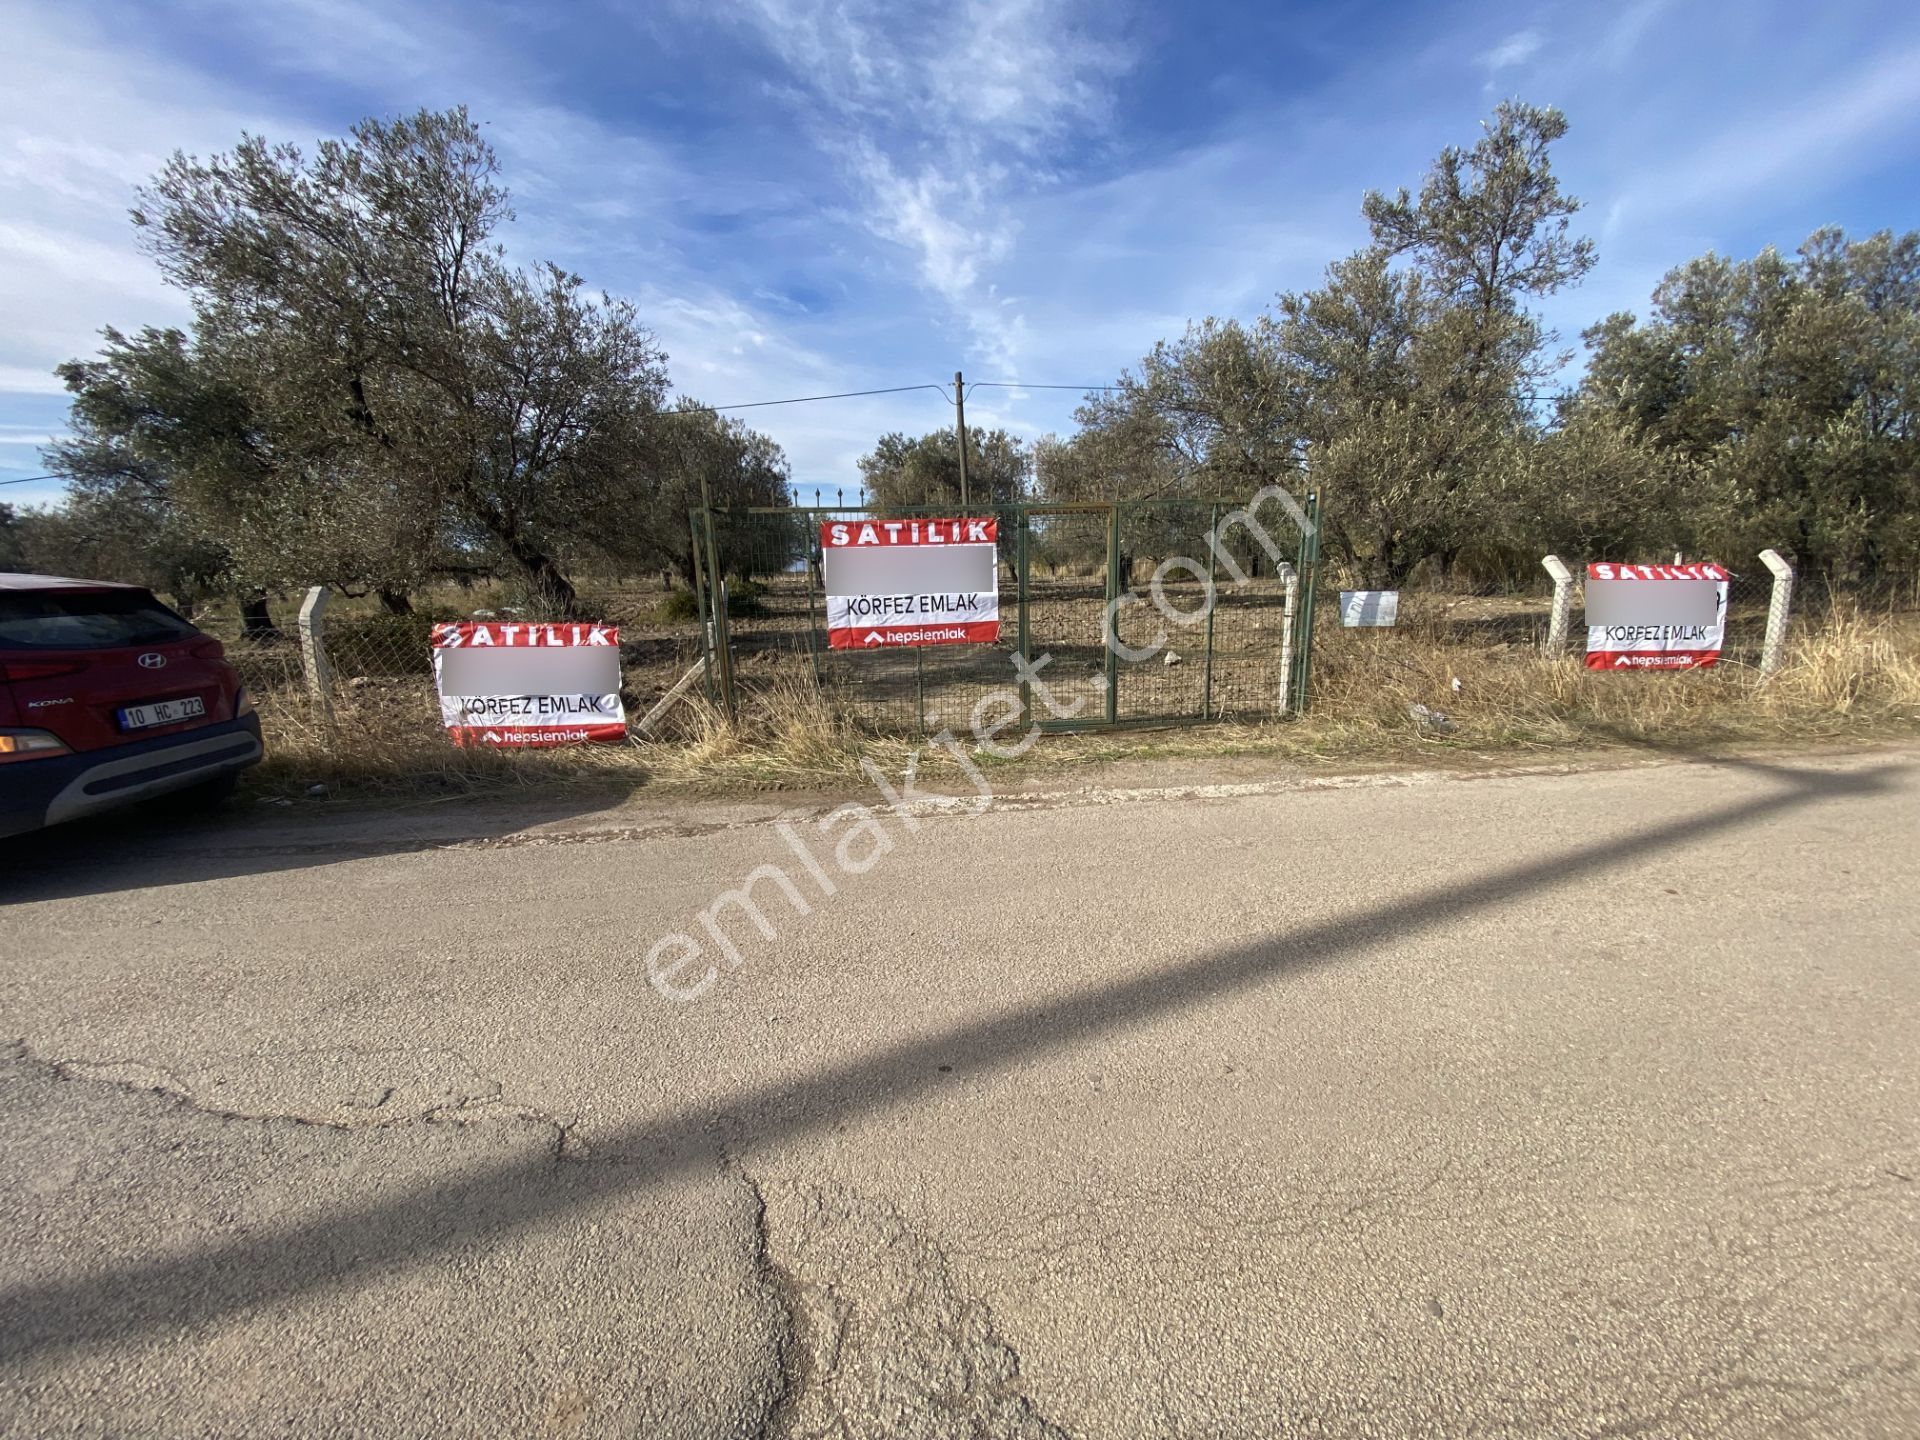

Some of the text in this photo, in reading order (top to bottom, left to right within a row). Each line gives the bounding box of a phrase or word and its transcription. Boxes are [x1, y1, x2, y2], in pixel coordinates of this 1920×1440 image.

[830, 521, 988, 546] SATILIK
[1595, 564, 1723, 580] SATILIK
[847, 593, 978, 616] KÖRFEZ EMLAK
[441, 625, 610, 648] SATILIK
[886, 628, 966, 644] hepsiemlak
[1663, 625, 1707, 640] EMLAK
[27, 697, 75, 708] KONA
[461, 694, 602, 715] KÖRFEZ EMLAK
[128, 708, 145, 726] 10
[153, 704, 173, 721] HC
[180, 698, 204, 716] 223
[503, 729, 590, 744] hepsiemlak
